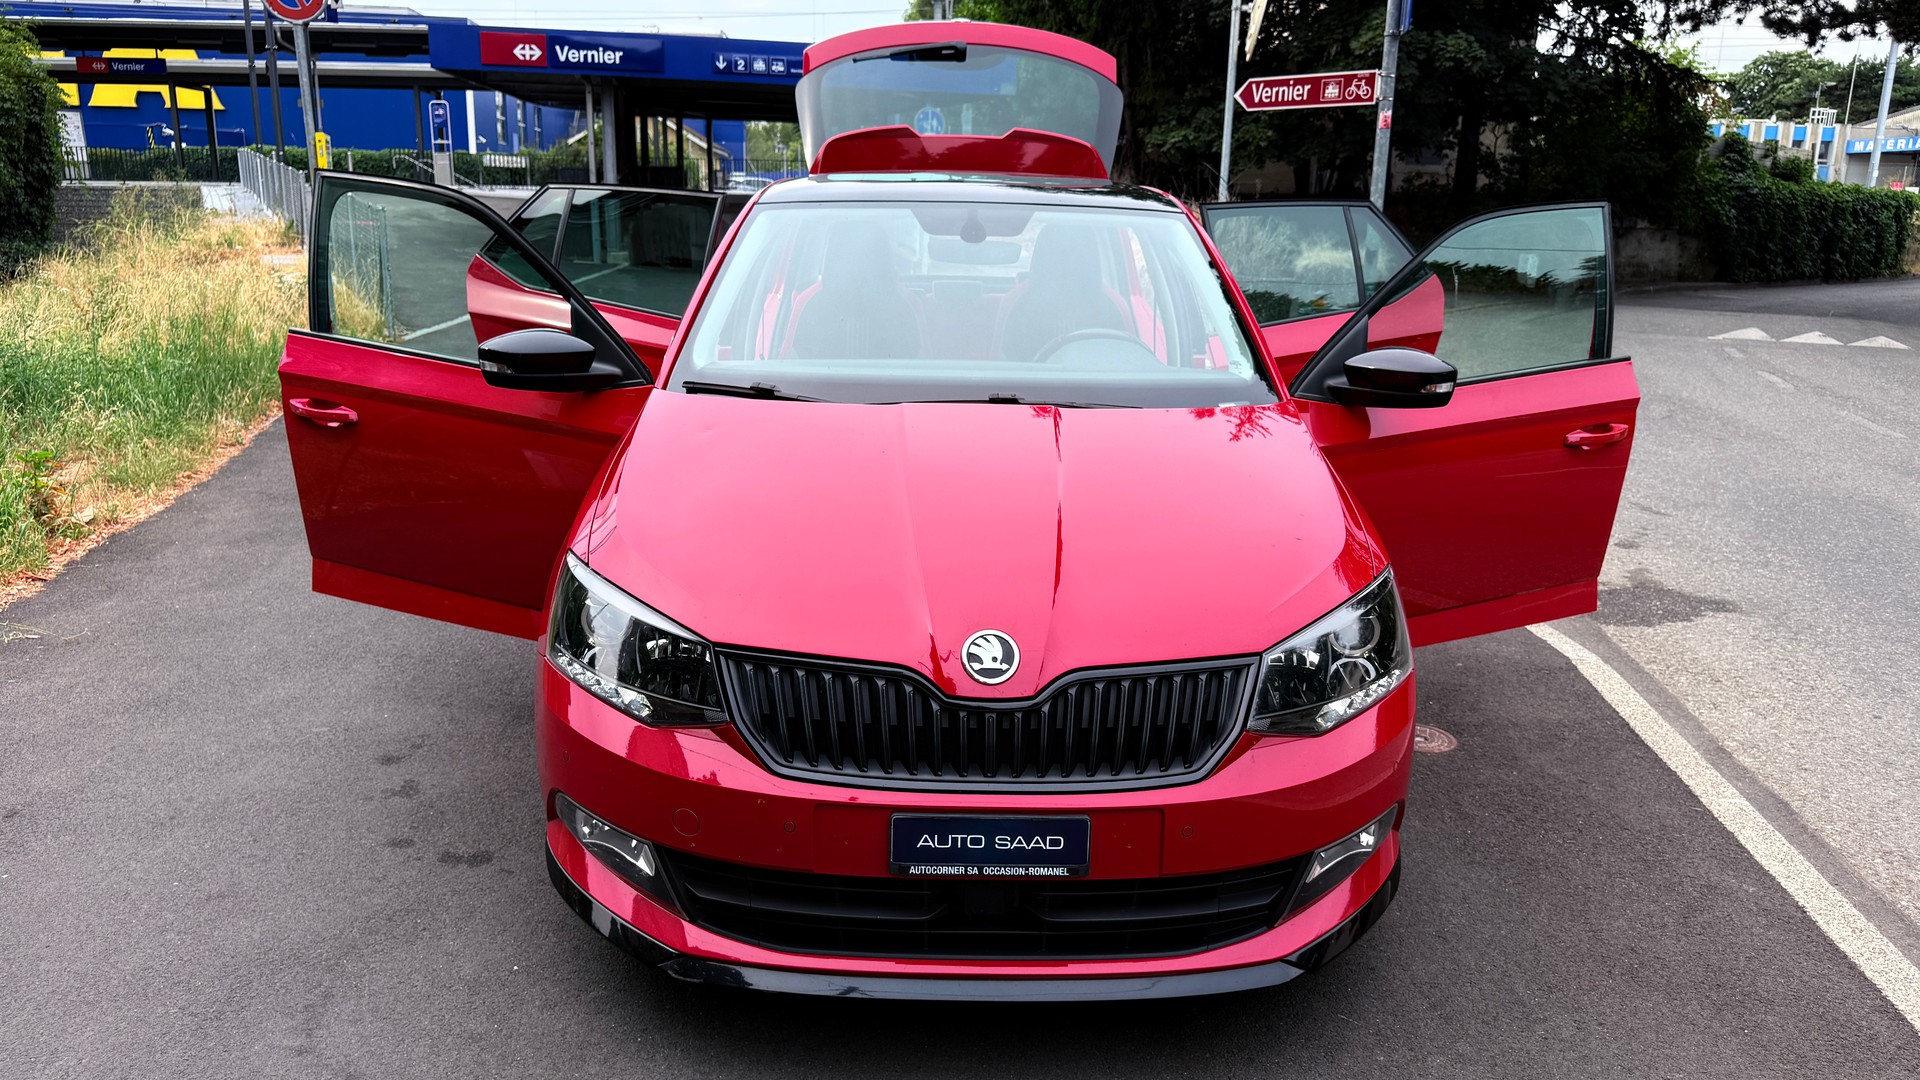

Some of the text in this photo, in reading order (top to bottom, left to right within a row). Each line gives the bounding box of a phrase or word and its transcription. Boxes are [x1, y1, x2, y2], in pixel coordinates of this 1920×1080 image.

[554, 44, 624, 65] Vernier
[111, 61, 146, 71] Vernier
[736, 59, 746, 71] 2
[1251, 79, 1312, 104] Vernier
[916, 834, 1064, 850] AUTO SAAD
[909, 865, 1070, 877] AUTOCORNER SA OCCASION-ROMANEL
